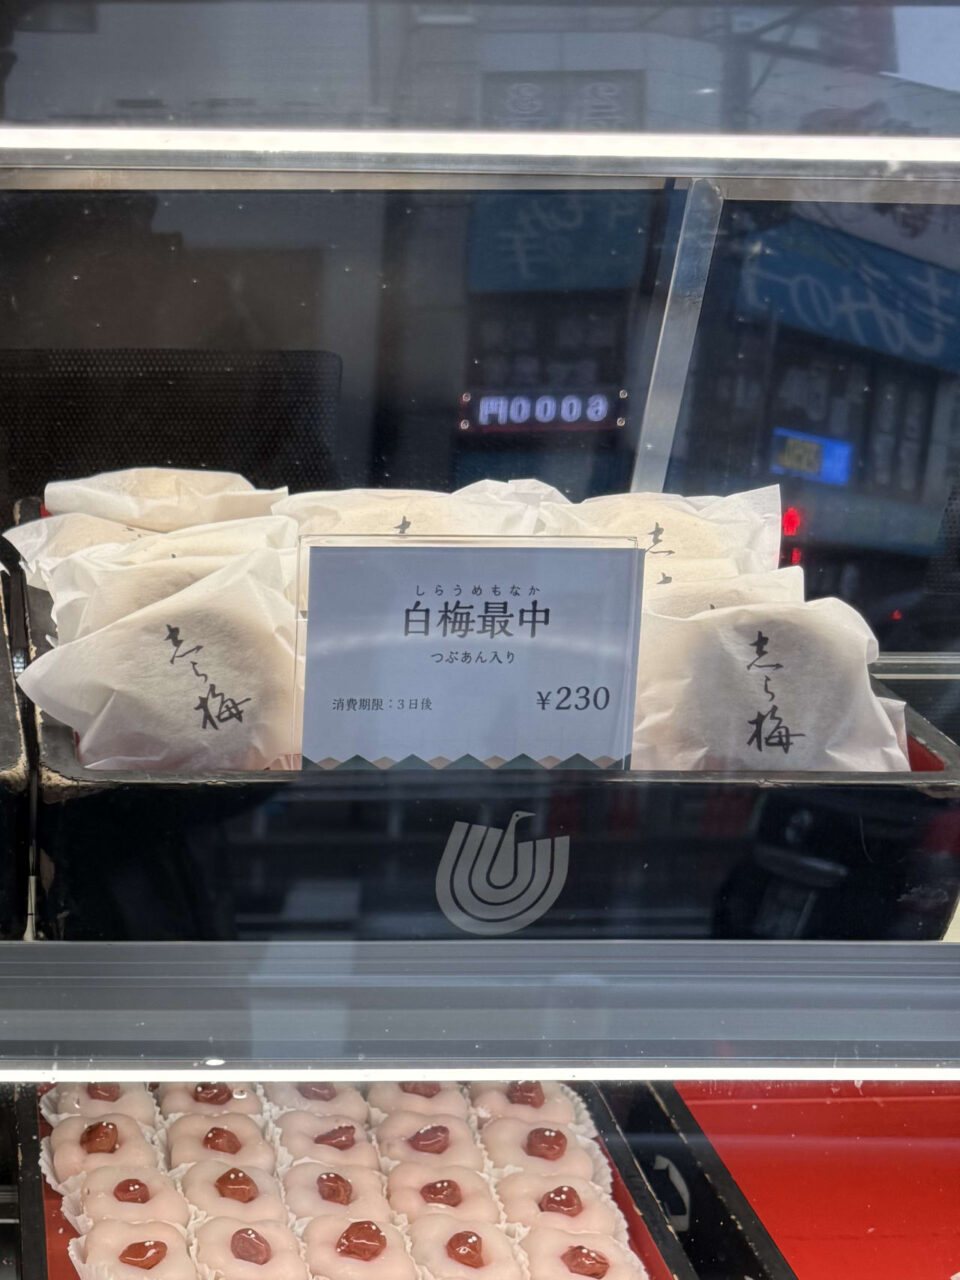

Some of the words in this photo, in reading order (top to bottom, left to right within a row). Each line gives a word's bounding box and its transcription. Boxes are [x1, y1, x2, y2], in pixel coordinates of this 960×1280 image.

[416, 584, 541, 597] しらうめもなか
[403, 600, 551, 639] 白梅最中
[431, 650, 515, 664] つぶあん入り
[536, 686, 611, 711] ¥230
